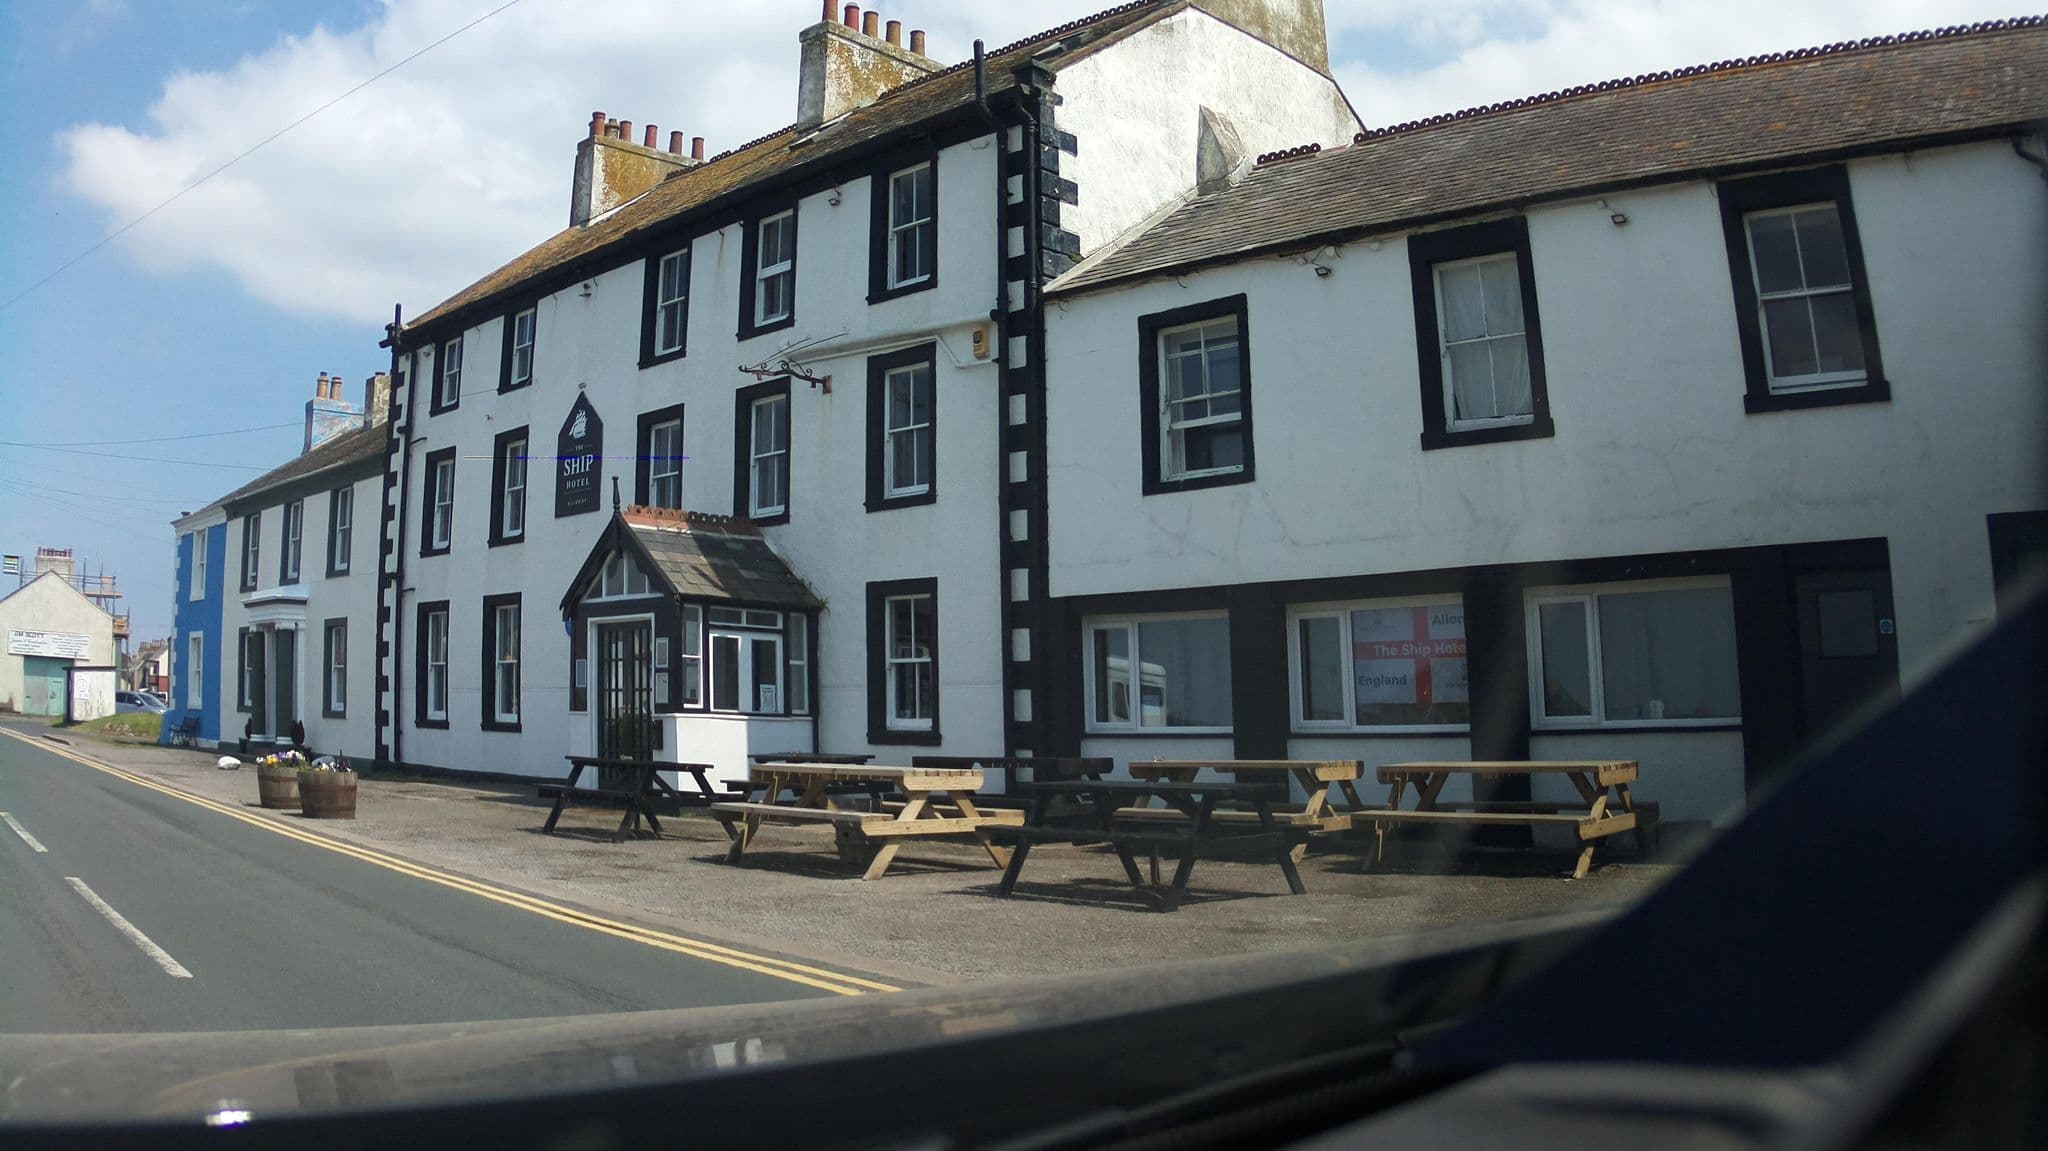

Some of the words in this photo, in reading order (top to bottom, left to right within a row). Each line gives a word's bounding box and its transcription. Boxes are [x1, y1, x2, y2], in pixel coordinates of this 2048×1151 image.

[563, 454, 594, 476] SHIP
[566, 478, 590, 489] HOTEL
[1374, 645, 1399, 657] The
[1401, 643, 1431, 658] Ship
[1358, 673, 1408, 689] England
